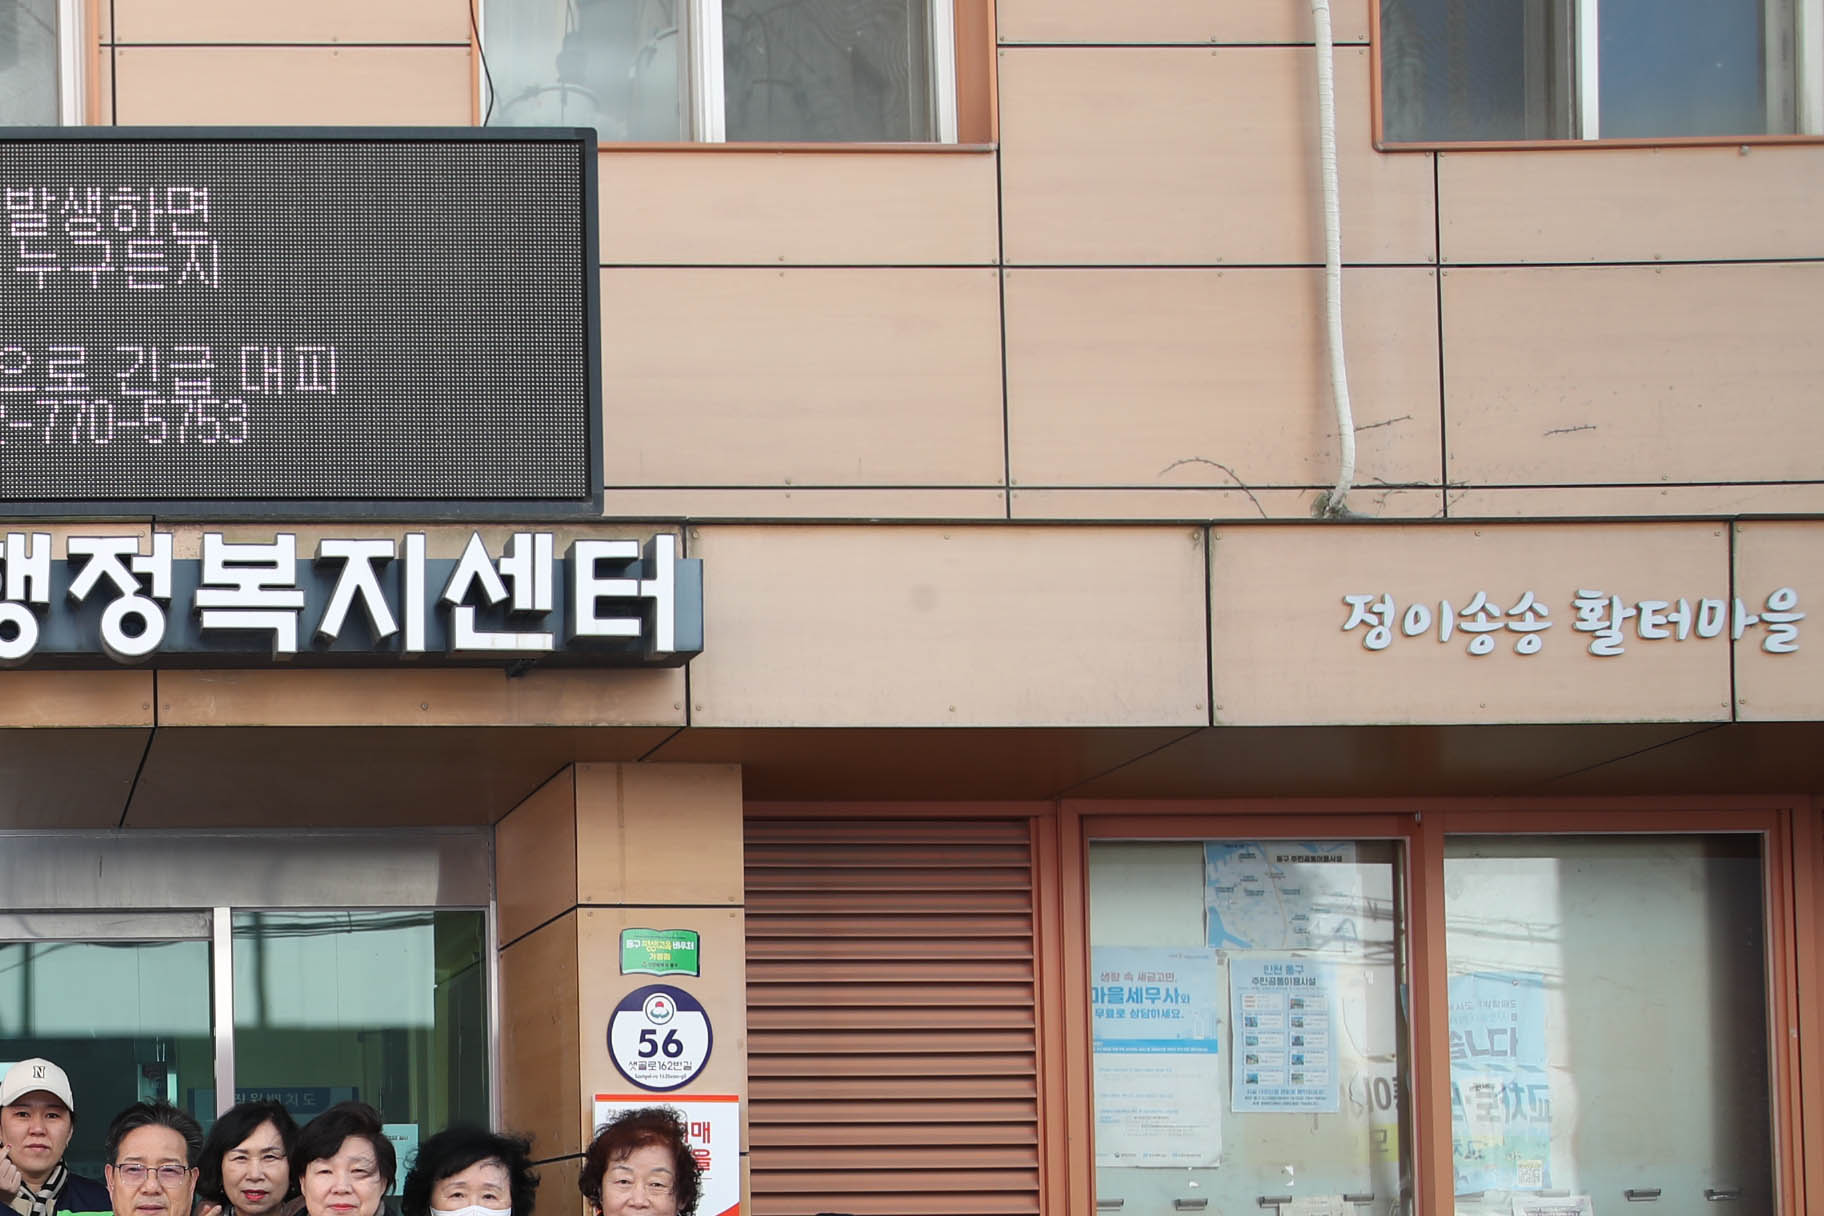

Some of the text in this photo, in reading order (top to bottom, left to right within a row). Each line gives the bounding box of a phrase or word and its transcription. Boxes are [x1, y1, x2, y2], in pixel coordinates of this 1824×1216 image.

[5, 186, 211, 238] 발생하면
[14, 238, 221, 290] 누구든지
[115, 345, 215, 398] 긴급
[239, 345, 339, 397] 대피
[1341, 590, 1553, 656] 정이송송
[638, 1029, 684, 1058] 56
